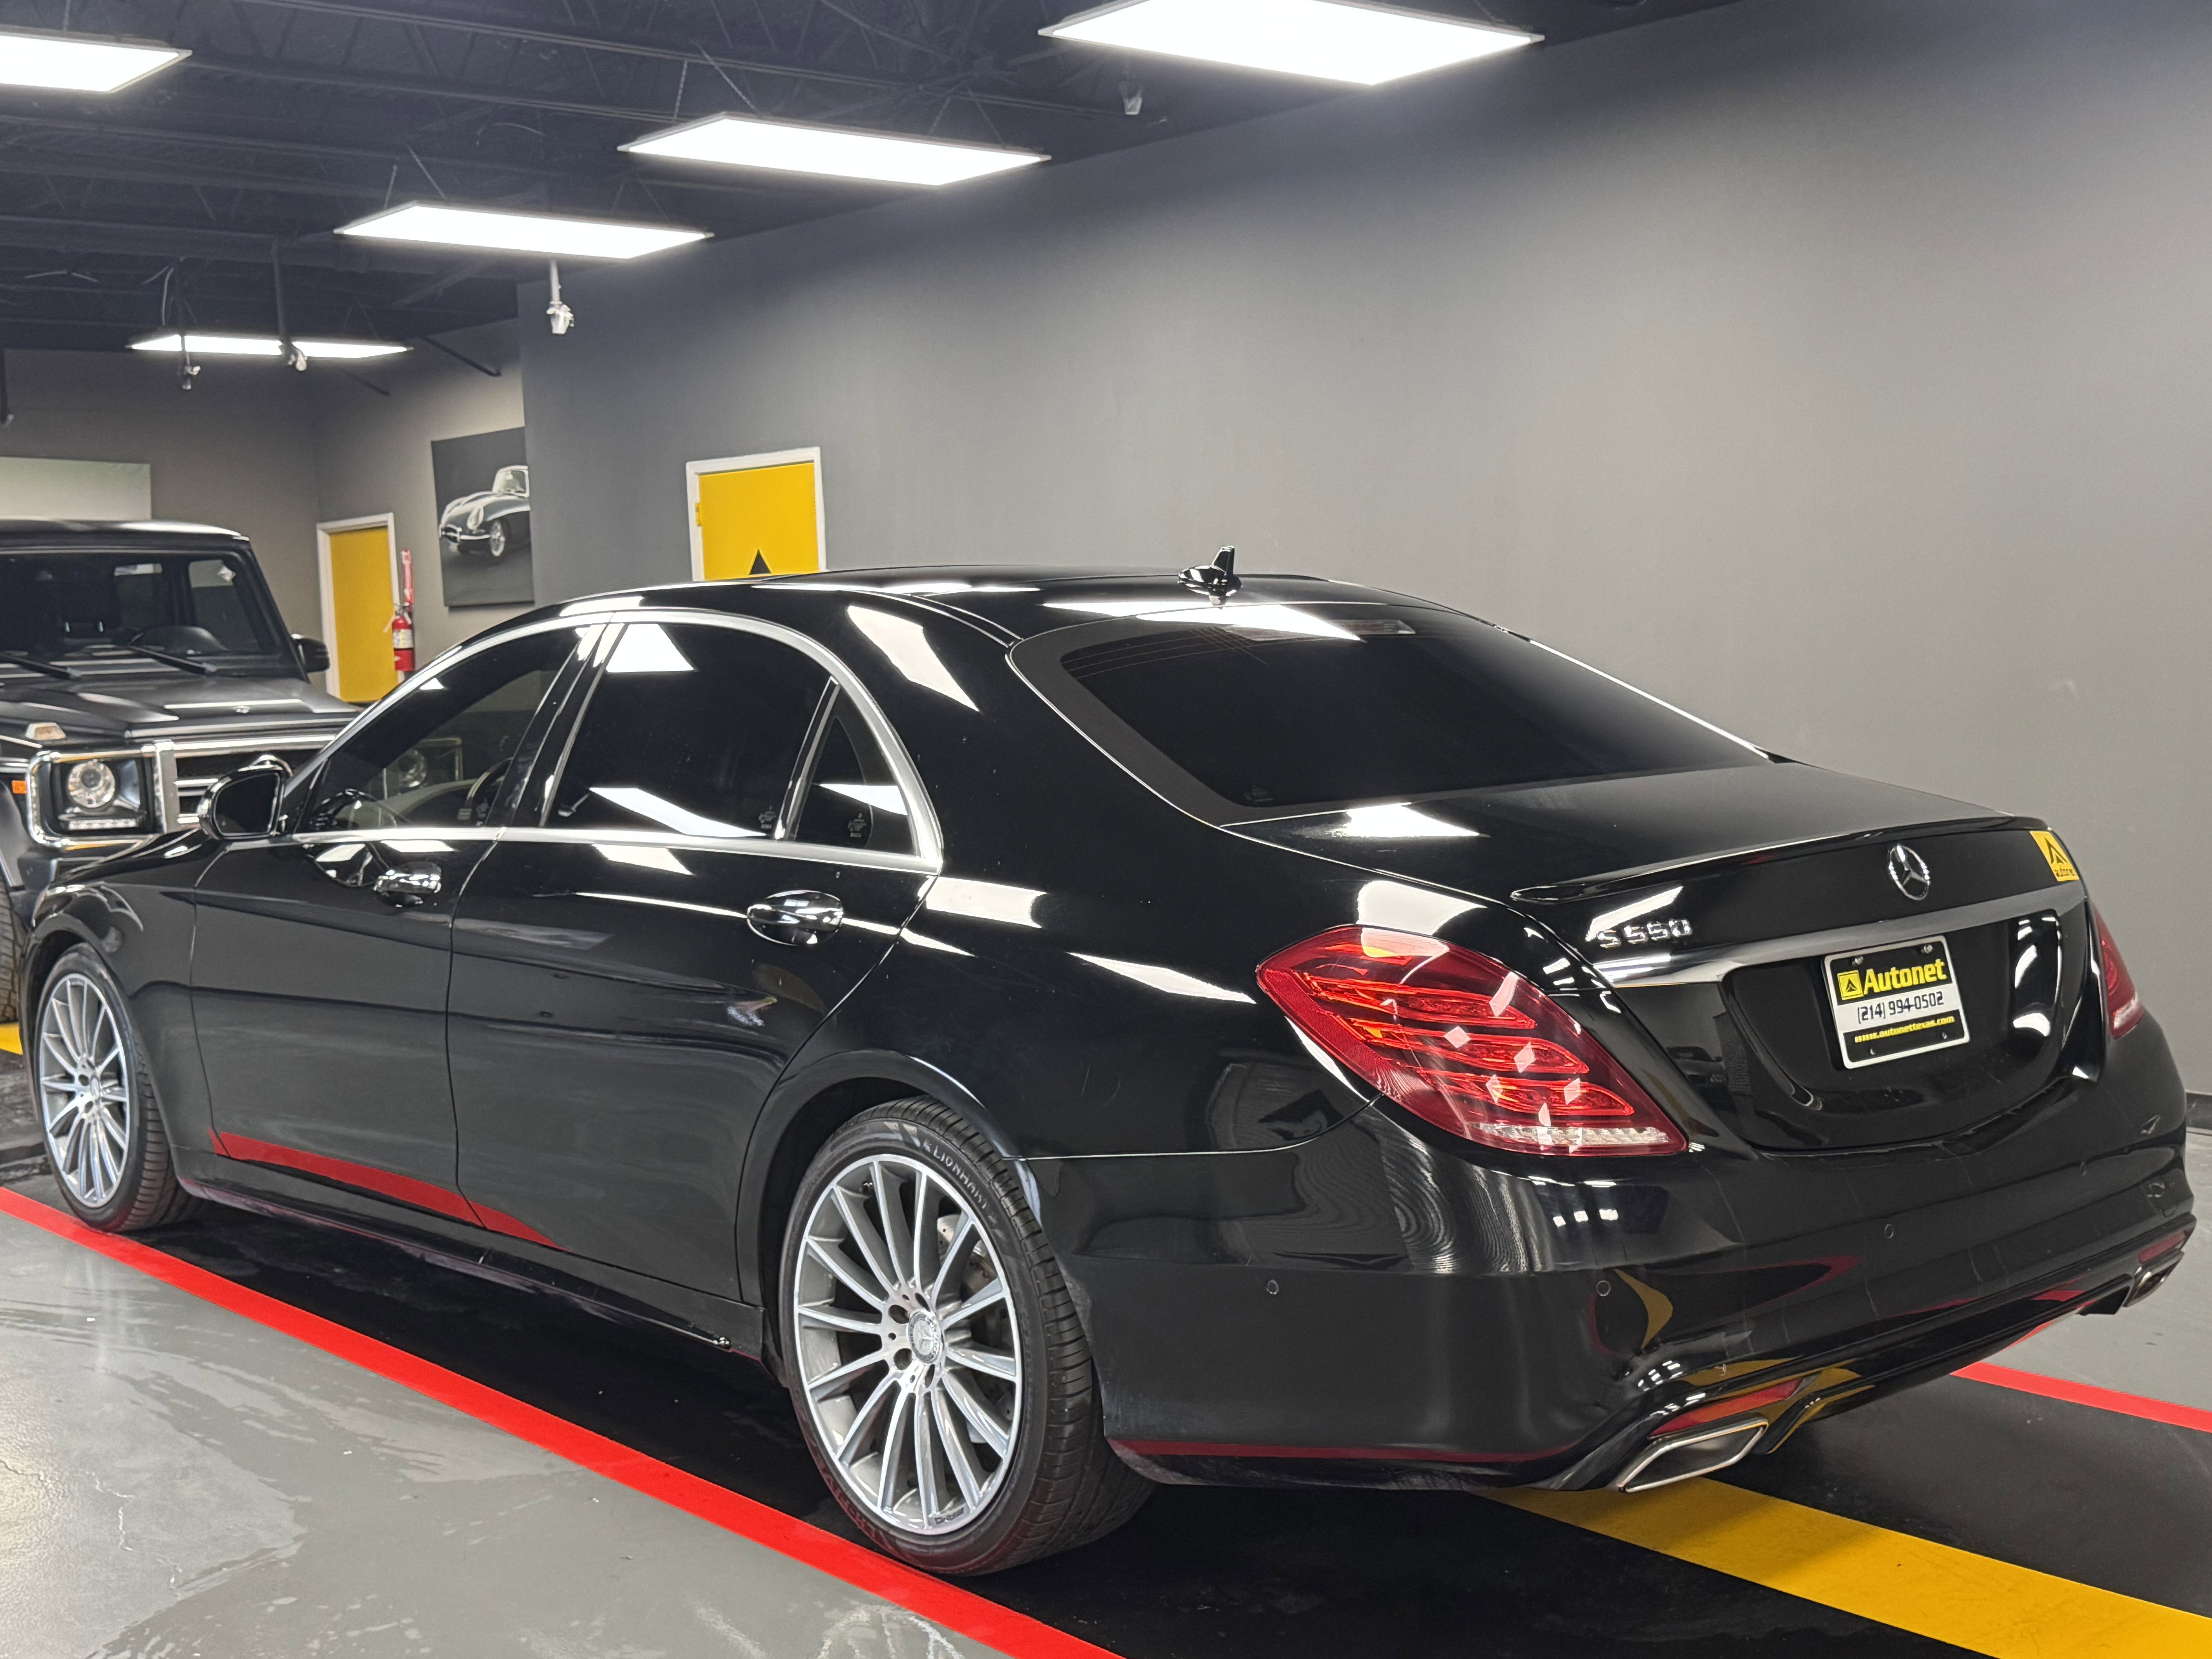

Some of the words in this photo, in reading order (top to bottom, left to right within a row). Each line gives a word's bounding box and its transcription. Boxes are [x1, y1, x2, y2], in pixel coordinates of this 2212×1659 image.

[1863, 958, 1948, 995] Autonet
[1857, 1002, 1886, 1024] (214)
[1888, 991, 1944, 1015] 994-0502
[1854, 1015, 1956, 1043] www.autonettexas.com
